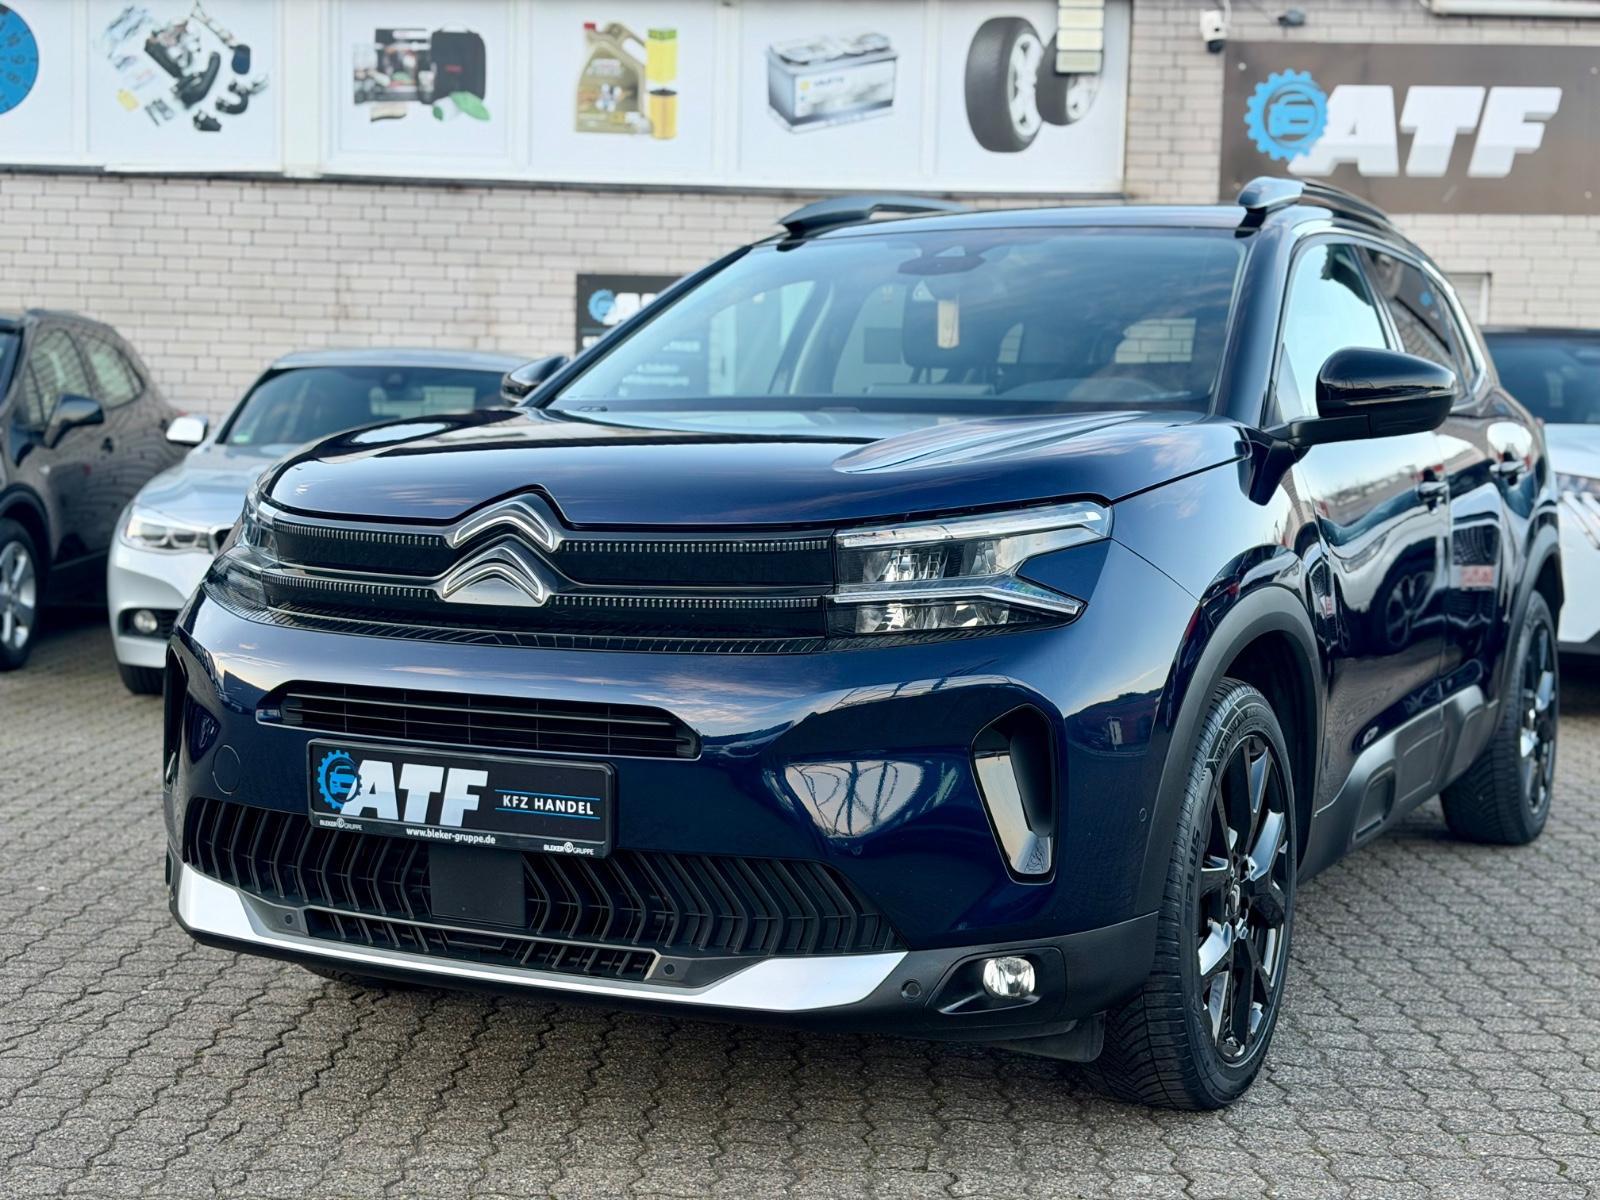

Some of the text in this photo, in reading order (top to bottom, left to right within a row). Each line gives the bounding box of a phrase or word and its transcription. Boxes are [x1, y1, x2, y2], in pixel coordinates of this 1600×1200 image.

[1288, 84, 1562, 177] ATF
[340, 759, 489, 827] ATF
[503, 795, 594, 815] KFZ HANDEL
[406, 828, 496, 844] www.bleker-gruppe.de
